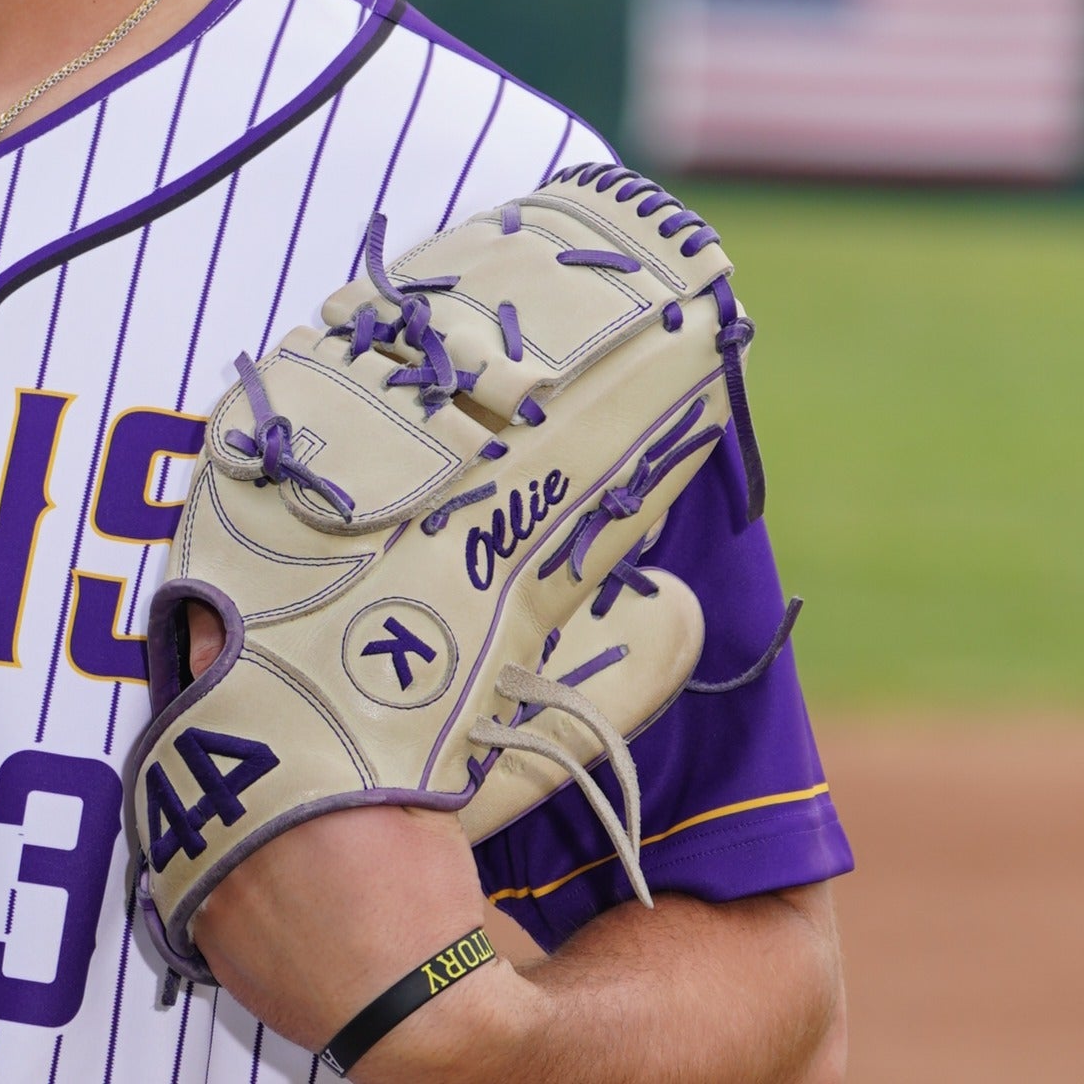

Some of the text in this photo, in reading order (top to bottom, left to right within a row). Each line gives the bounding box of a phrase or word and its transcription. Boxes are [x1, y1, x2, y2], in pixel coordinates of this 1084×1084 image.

[466, 469, 570, 591] Ollie
[360, 616, 437, 692] K
[145, 726, 280, 874] 44
